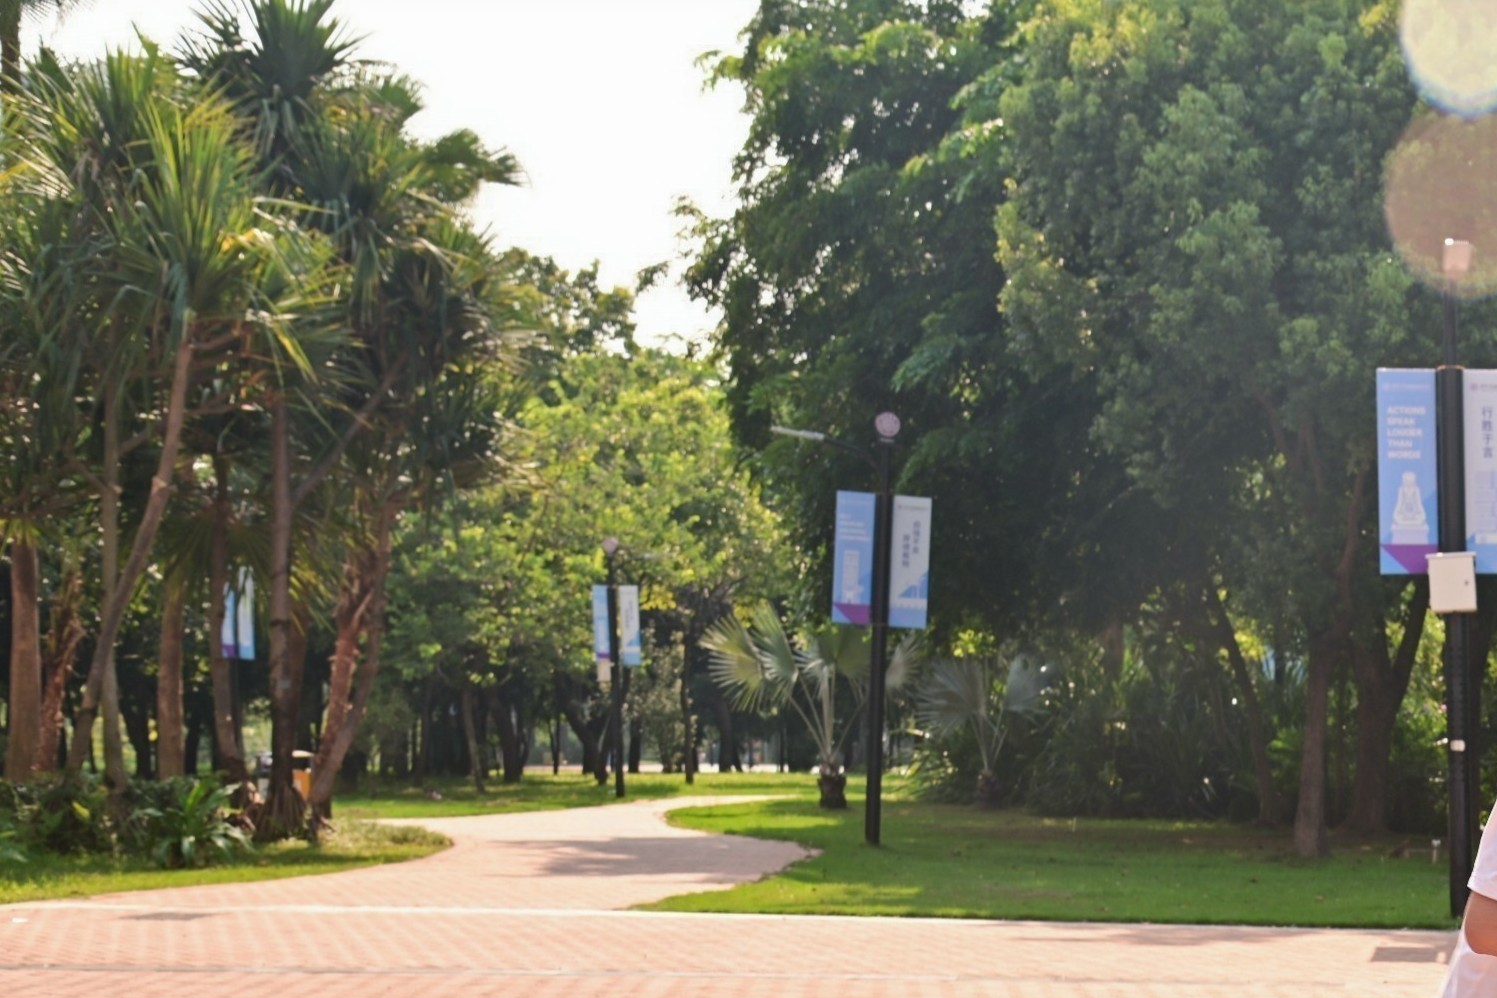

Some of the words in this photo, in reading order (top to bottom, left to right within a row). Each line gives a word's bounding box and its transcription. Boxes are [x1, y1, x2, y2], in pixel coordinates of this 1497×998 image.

[1387, 405, 1426, 416] ACTIONS
[1387, 417, 1416, 427] SPEAK
[1387, 428, 1423, 438] LOUDER
[1387, 439, 1413, 449] THAN
[1387, 450, 1422, 460] WORDS
